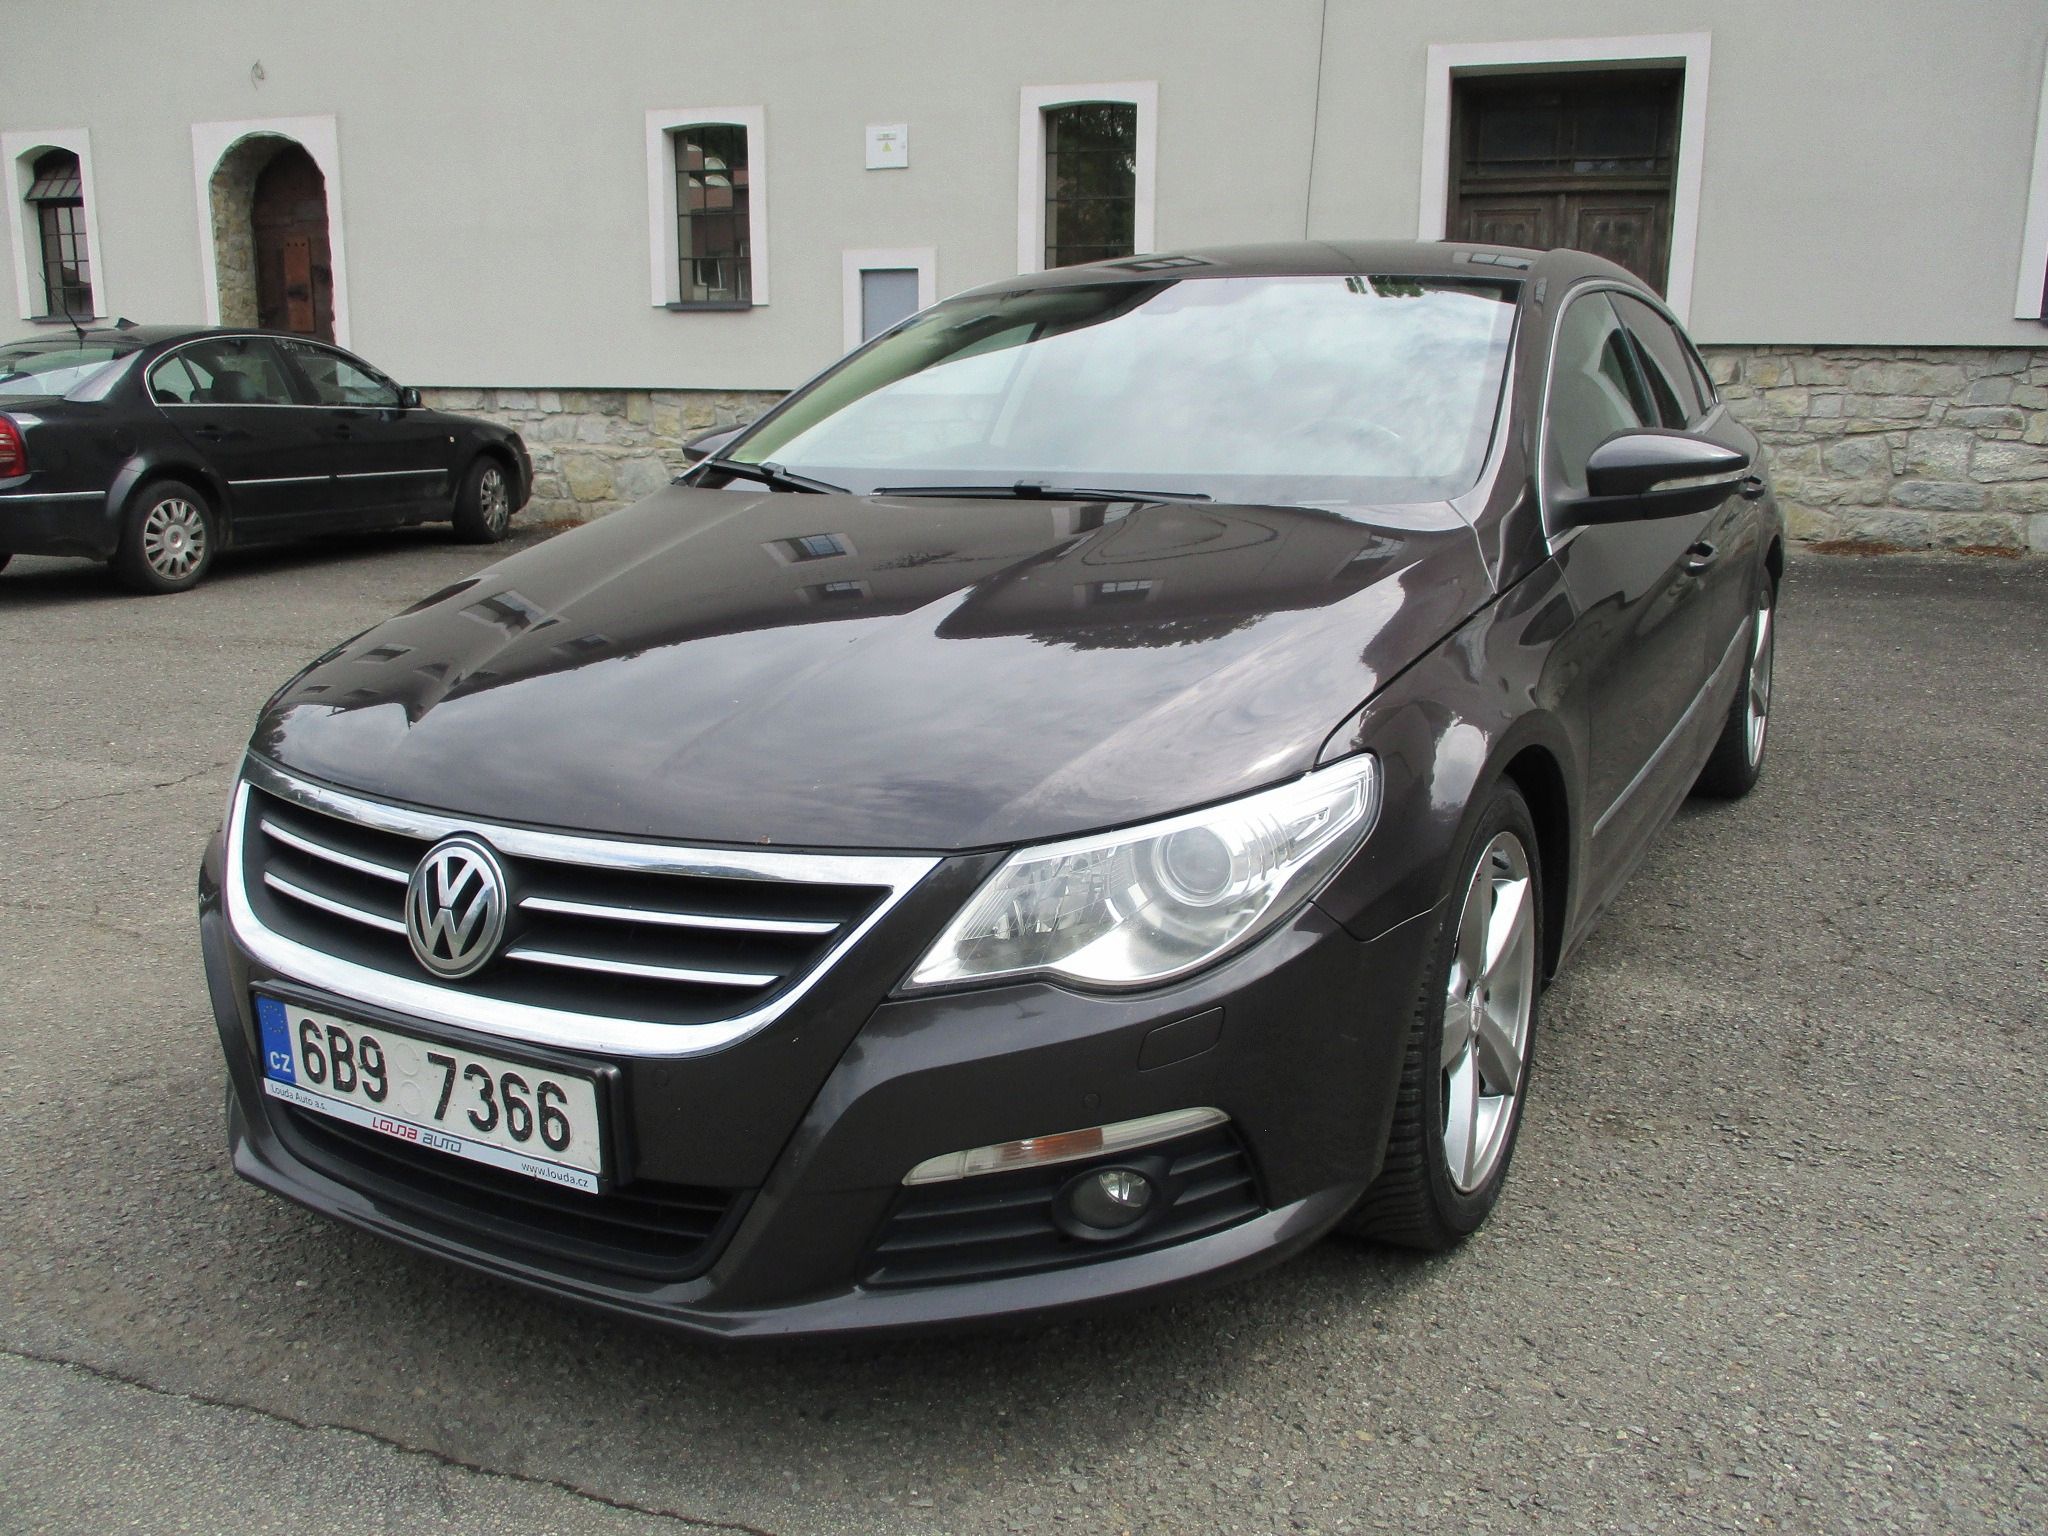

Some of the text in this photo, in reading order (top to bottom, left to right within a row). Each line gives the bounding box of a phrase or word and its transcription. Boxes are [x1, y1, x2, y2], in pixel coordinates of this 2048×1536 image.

[269, 1051, 292, 1074] CZ
[271, 1084, 294, 1100] Louda
[295, 1092, 313, 1106] Auto
[299, 1018, 571, 1152] 6B9 7366
[521, 1162, 589, 1188] www.louda.cz
